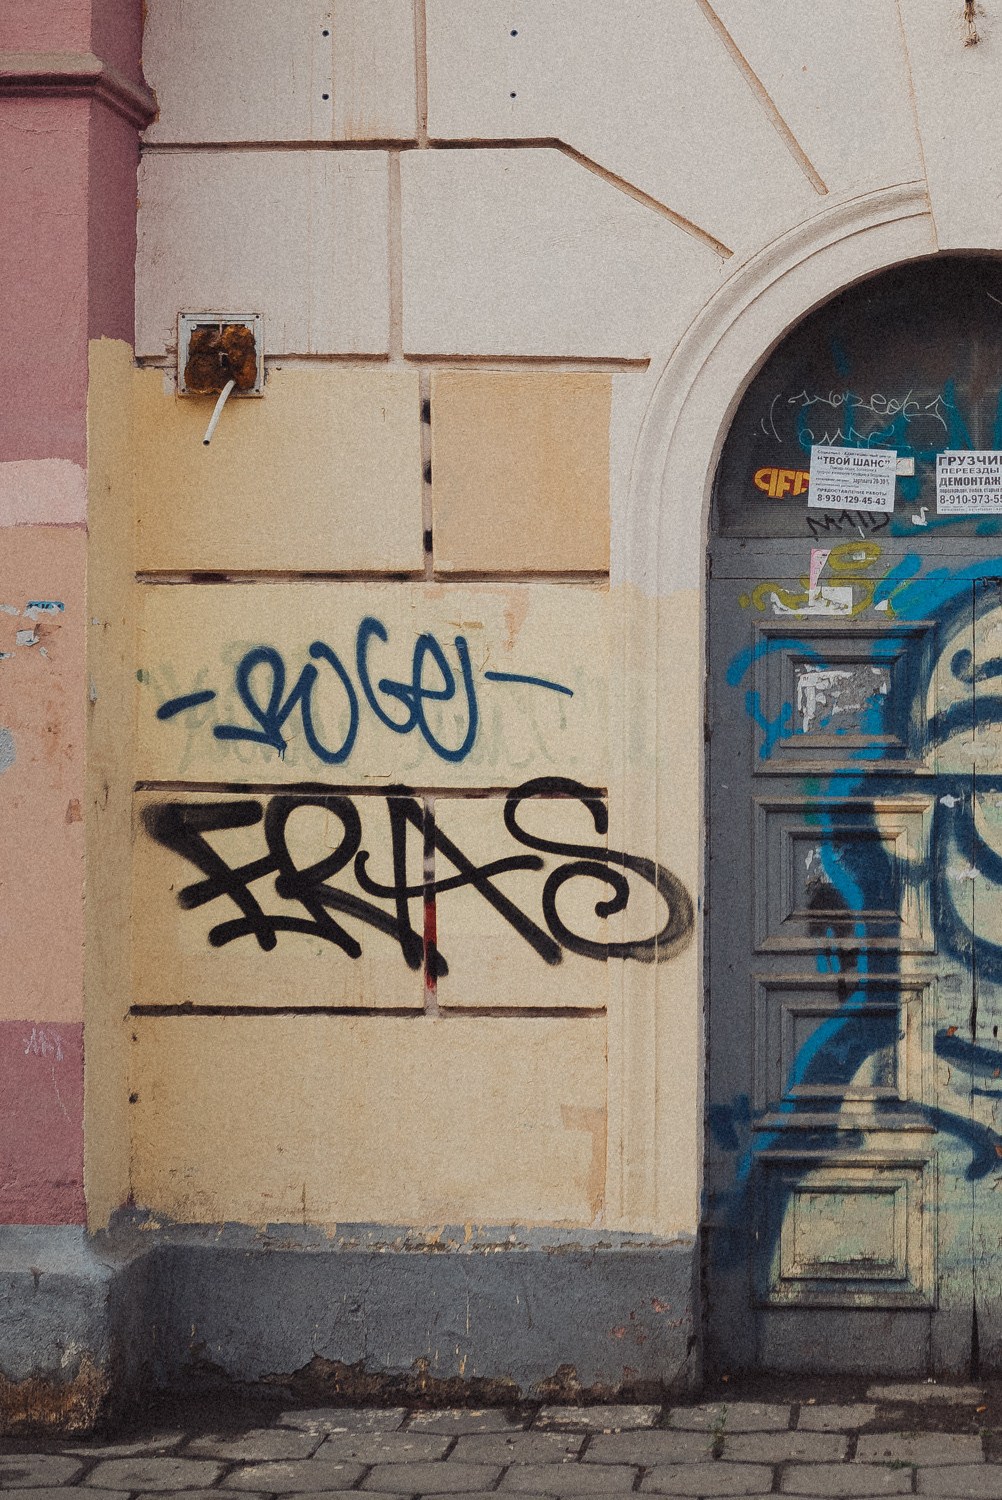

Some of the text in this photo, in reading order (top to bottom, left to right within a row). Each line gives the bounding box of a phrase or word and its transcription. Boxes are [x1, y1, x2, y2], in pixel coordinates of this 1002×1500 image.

[941, 467, 1000, 475] ПЕРЕЕЗДЫ
[940, 476, 1001, 488] ДЕМОНТАЖ
[816, 487, 865, 495] ПРЕДОСТАВЛЕНИЕ
[817, 494, 887, 506] 8-930-129-45-43
